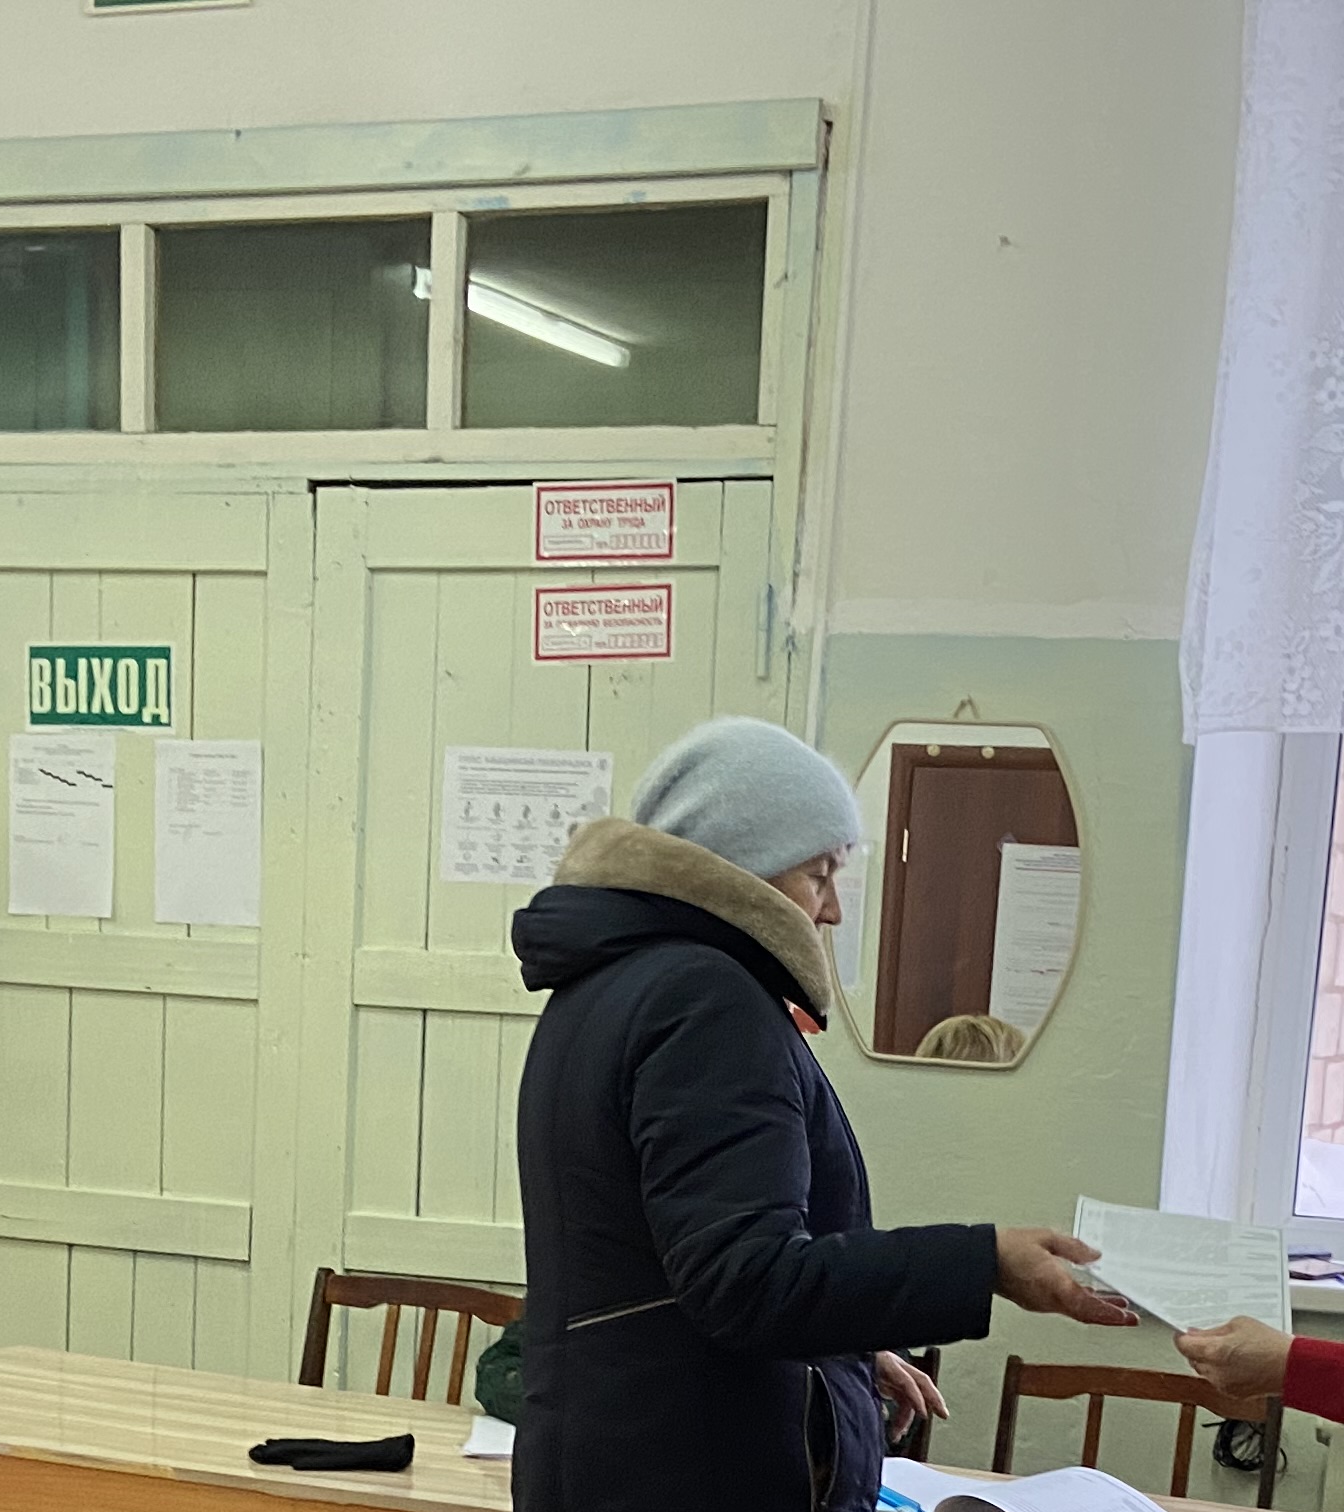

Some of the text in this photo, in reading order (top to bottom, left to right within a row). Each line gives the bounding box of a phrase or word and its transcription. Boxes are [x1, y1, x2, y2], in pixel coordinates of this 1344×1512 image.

[544, 494, 666, 516] ОТВЕТСТВЕННЫЙ
[561, 518, 573, 529] ЗА
[543, 594, 664, 617] ОТВЕТСТВЕННЫЙ
[30, 657, 170, 724] ВЫХОД
